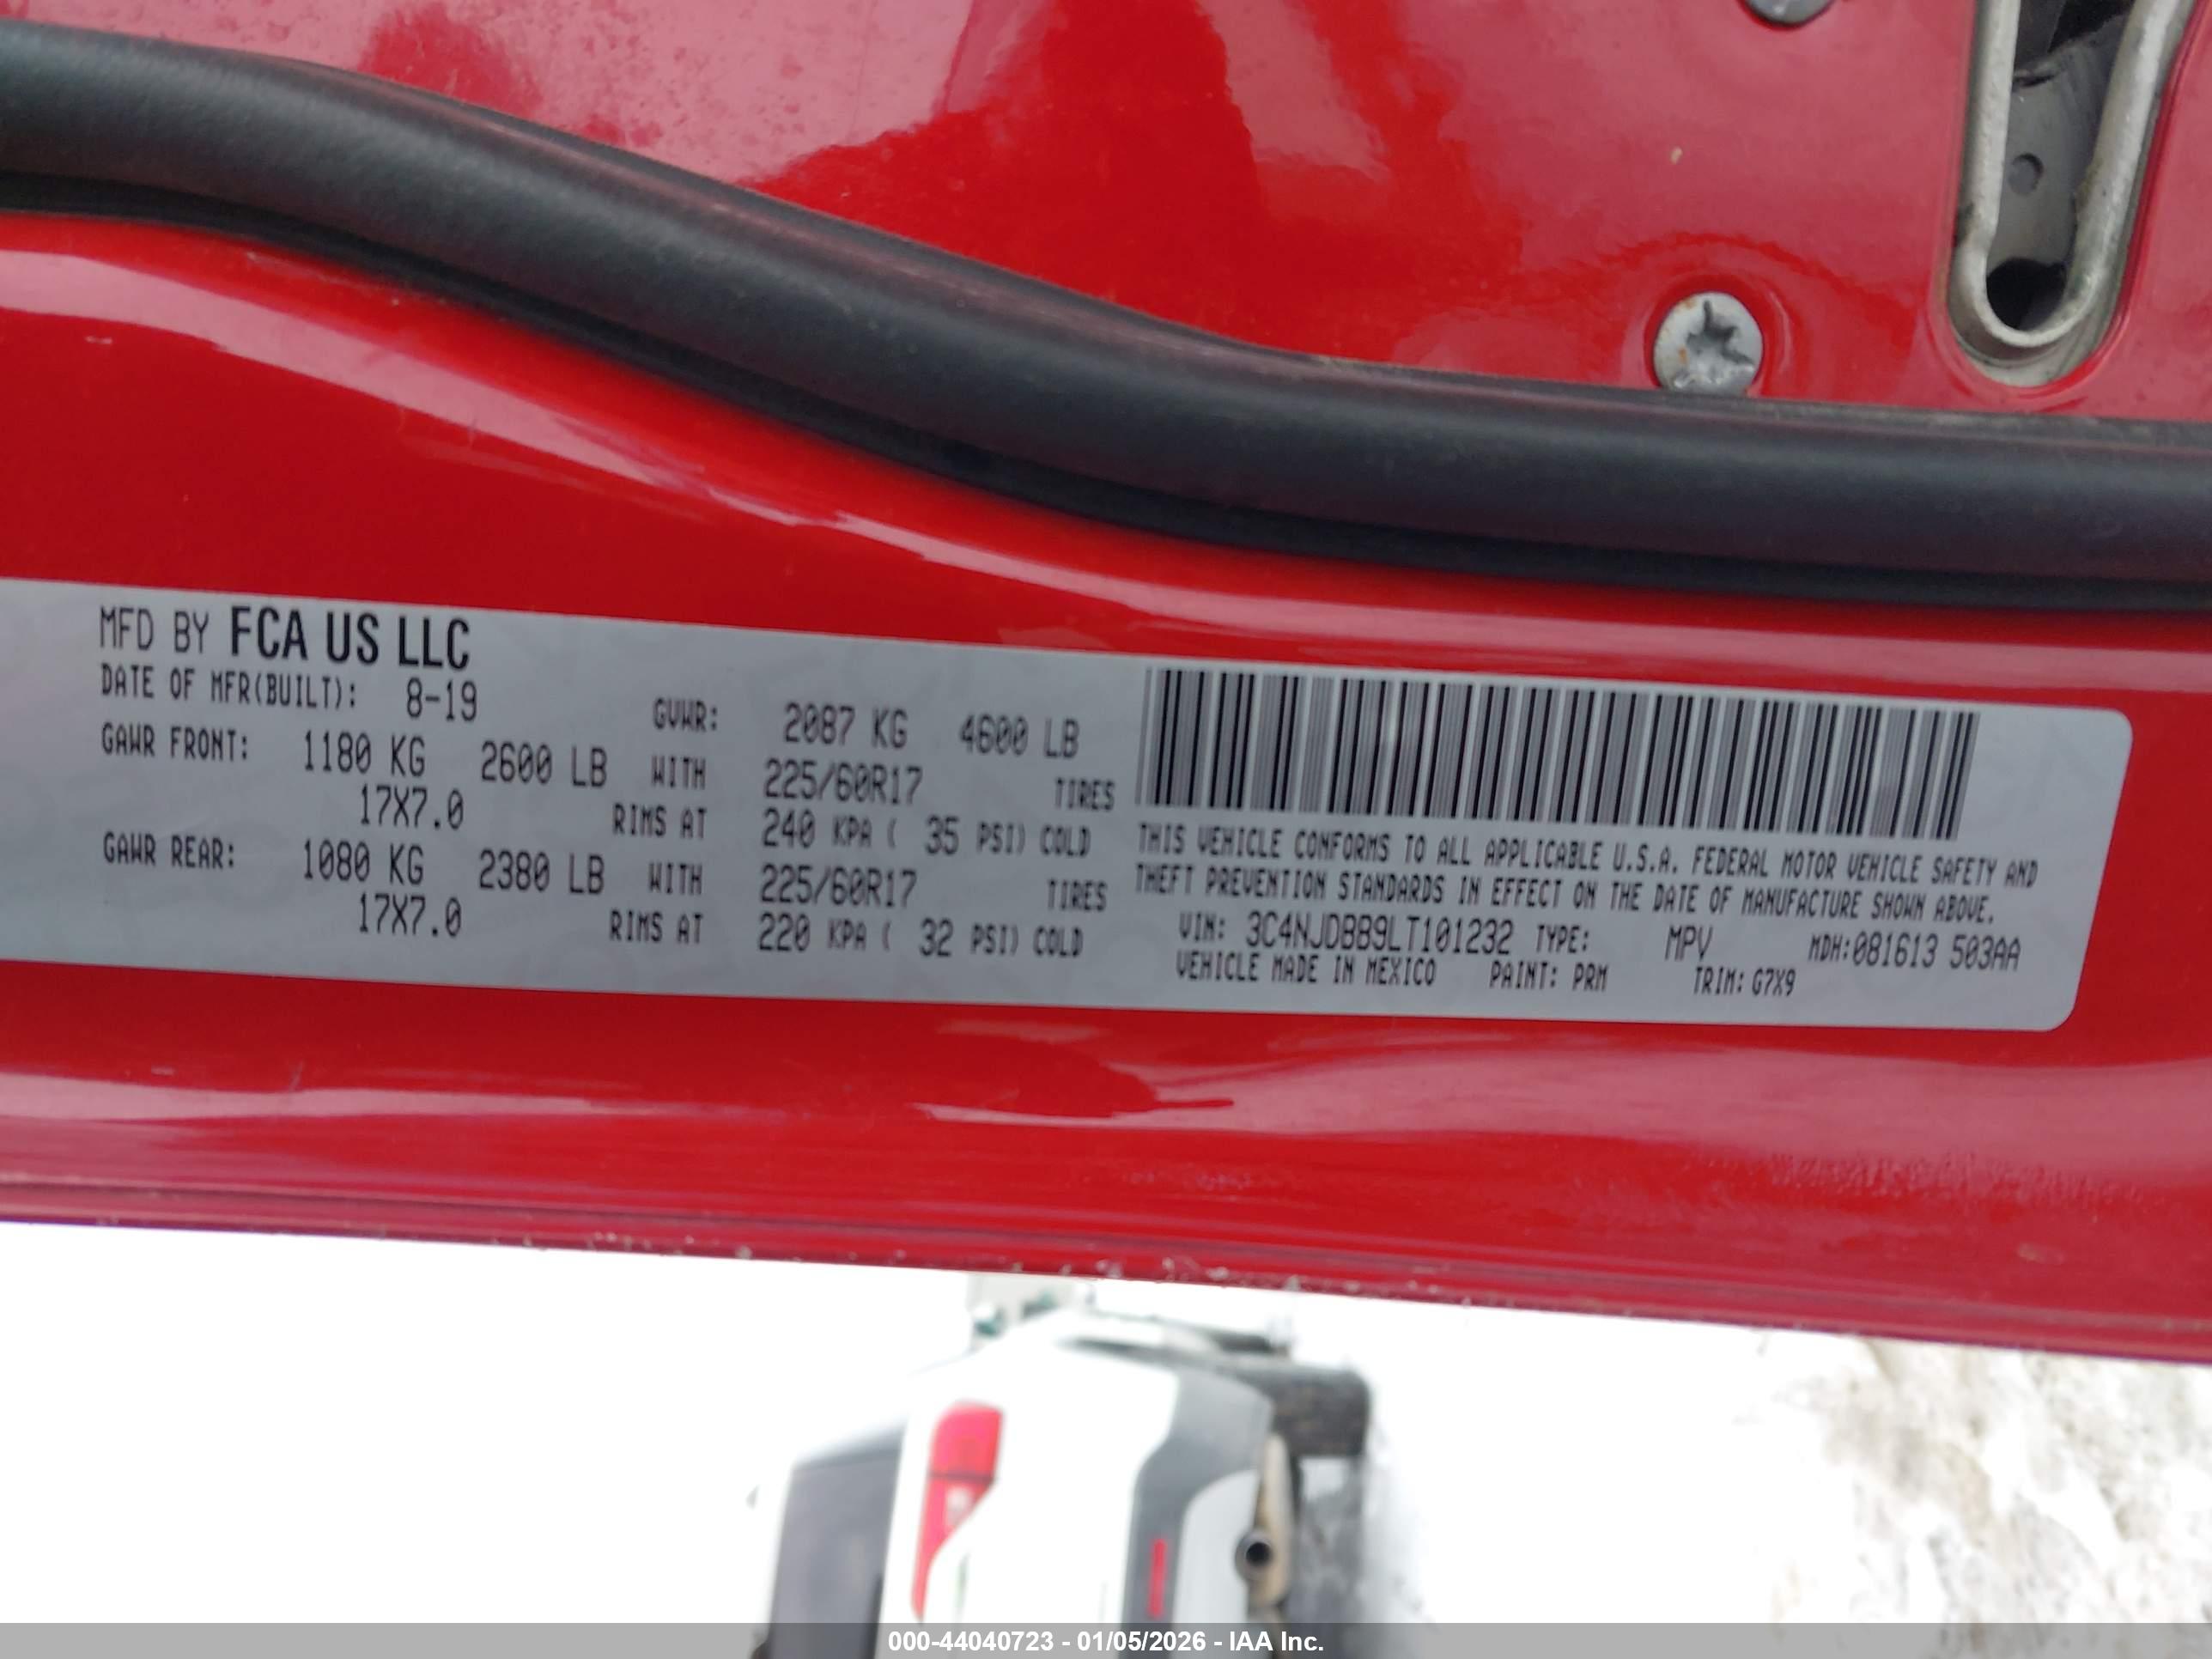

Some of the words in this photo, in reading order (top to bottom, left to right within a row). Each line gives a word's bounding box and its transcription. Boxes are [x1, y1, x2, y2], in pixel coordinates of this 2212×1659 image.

[100, 607, 153, 650] MFD
[175, 611, 208, 653] BY
[232, 607, 307, 659] FCA
[327, 613, 378, 665] US
[399, 618, 468, 670] LLC
[101, 663, 153, 698] DATE
[171, 668, 194, 699] OF
[212, 671, 355, 708] MFR(BUILT):
[407, 678, 477, 721] 8-19
[654, 698, 717, 730] GVWR:
[785, 702, 854, 744] 2087
[874, 708, 907, 748] KG
[961, 714, 1027, 755] 4600
[1046, 719, 1079, 758] LB
[102, 722, 155, 756] GAWR
[172, 726, 246, 761] FRONT:
[306, 731, 370, 773] 1180
[392, 735, 424, 776] KG
[482, 741, 551, 784] 2600
[573, 747, 606, 787] LB
[653, 757, 705, 787] WITH
[765, 758, 921, 805] 225/60R17
[1056, 778, 1114, 811] TIRES
[362, 784, 463, 830] 17X7.0
[614, 803, 665, 836] RIMS
[682, 807, 706, 838] AT
[763, 808, 814, 848] 240
[834, 816, 870, 843] KPA
[927, 815, 957, 855] 35
[979, 822, 1024, 854] PSI)
[1042, 826, 1089, 856] COLD
[104, 831, 155, 864] GAWR
[172, 836, 234, 868] REAR:
[305, 840, 369, 881] 1080
[391, 844, 422, 884] KG
[480, 849, 549, 891] 2380
[570, 855, 604, 894] LB
[650, 863, 702, 894] WITH
[761, 863, 916, 907] 225/60R17
[1049, 879, 1106, 911] TIRES
[1140, 823, 1184, 854] THIS
[1200, 827, 1282, 858] VEHICLE
[1296, 831, 1389, 862] CONFORMS
[1406, 835, 1425, 863] TO
[1437, 838, 1469, 866] ALL
[1485, 838, 1602, 870] APPLICABLE
[1613, 844, 1676, 872] U.S.A.
[1692, 846, 1767, 877] FEDERAL
[1782, 851, 1836, 878] MOTOR
[1848, 854, 1922, 883] VEHICLE
[1932, 857, 1996, 884] SAFETY
[2006, 860, 2038, 888] AND
[1138, 863, 1193, 893] THEFT
[1207, 866, 1325, 898] PREVENTION
[1339, 872, 1444, 903] STANDARDS
[1460, 876, 1479, 904] IN
[1492, 878, 1561, 907] EFFECT
[1574, 881, 1595, 908] ON
[1612, 882, 1642, 910] THE
[1654, 884, 1698, 912] DATE
[1710, 886, 1731, 913] OF
[1742, 889, 1862, 918] MANUFACTURE
[1872, 892, 1923, 919] SHOWN
[1936, 895, 1993, 923] ABOVE.
[360, 893, 461, 937] 17X7.0
[611, 910, 662, 942] RIMS
[678, 913, 702, 943] AT
[759, 912, 809, 951] 220
[830, 920, 866, 948] KPA
[921, 918, 952, 957] 32
[972, 924, 1018, 954] PSI)
[1035, 927, 1082, 957] COLD
[1180, 913, 1224, 941] VIN:
[1247, 911, 1513, 955] 3C4NJDBB9LT101232
[1537, 925, 1589, 953] TYPE:
[1665, 926, 1711, 960] MPV
[1808, 932, 1937, 968] MDH:081613
[1950, 934, 2021, 969] 503AA
[1177, 952, 1260, 981] VEHICLE
[1273, 955, 1318, 982] MADE
[1334, 956, 1352, 983] IN
[1366, 957, 1435, 986] MEXICO
[1490, 960, 1556, 988] PAINT:
[1573, 963, 1607, 989] PRM
[1695, 967, 1743, 994] TRIM:
[1753, 968, 1796, 996] G7X9
